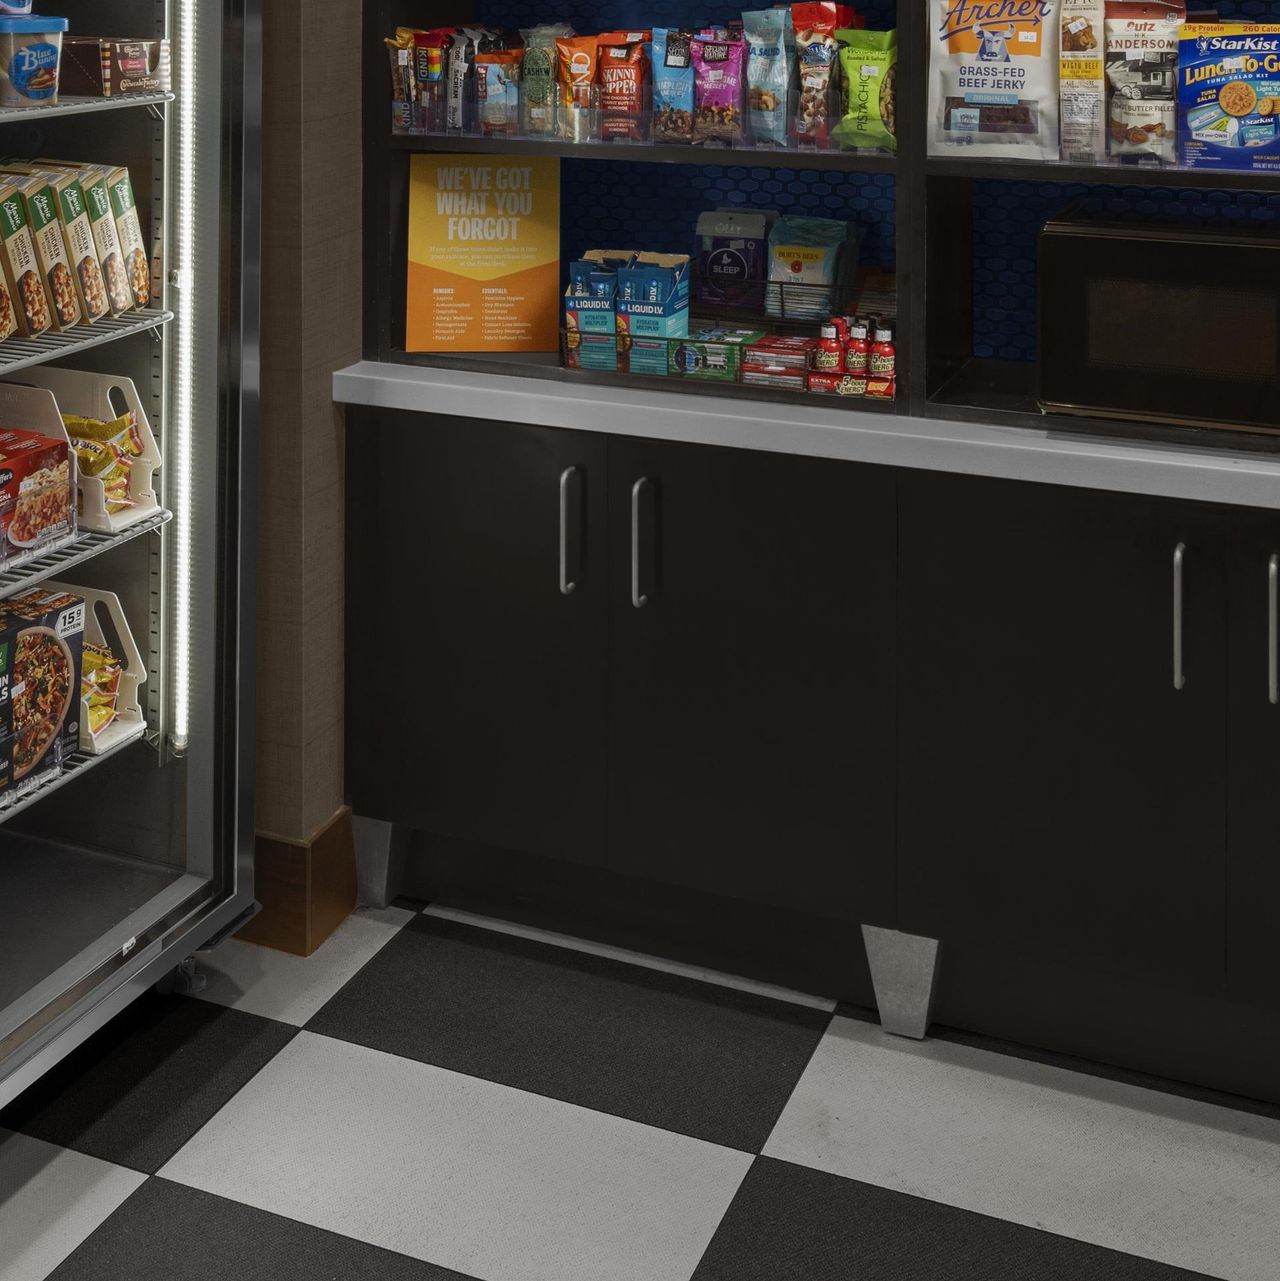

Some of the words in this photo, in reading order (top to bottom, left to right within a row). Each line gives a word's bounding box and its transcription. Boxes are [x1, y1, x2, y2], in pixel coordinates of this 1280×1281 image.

[1108, 39, 1174, 49] ANDERSON
[1210, 38, 1279, 50] StarKist
[959, 66, 1025, 77] GRASS-FED
[959, 78, 987, 89] BEEF
[990, 79, 1025, 90] JERKY
[437, 168, 491, 190] WE'VE
[436, 192, 489, 215] WHAT
[495, 192, 532, 215] YOU
[448, 218, 520, 240] FORGOT
[713, 265, 739, 273] SLEEP
